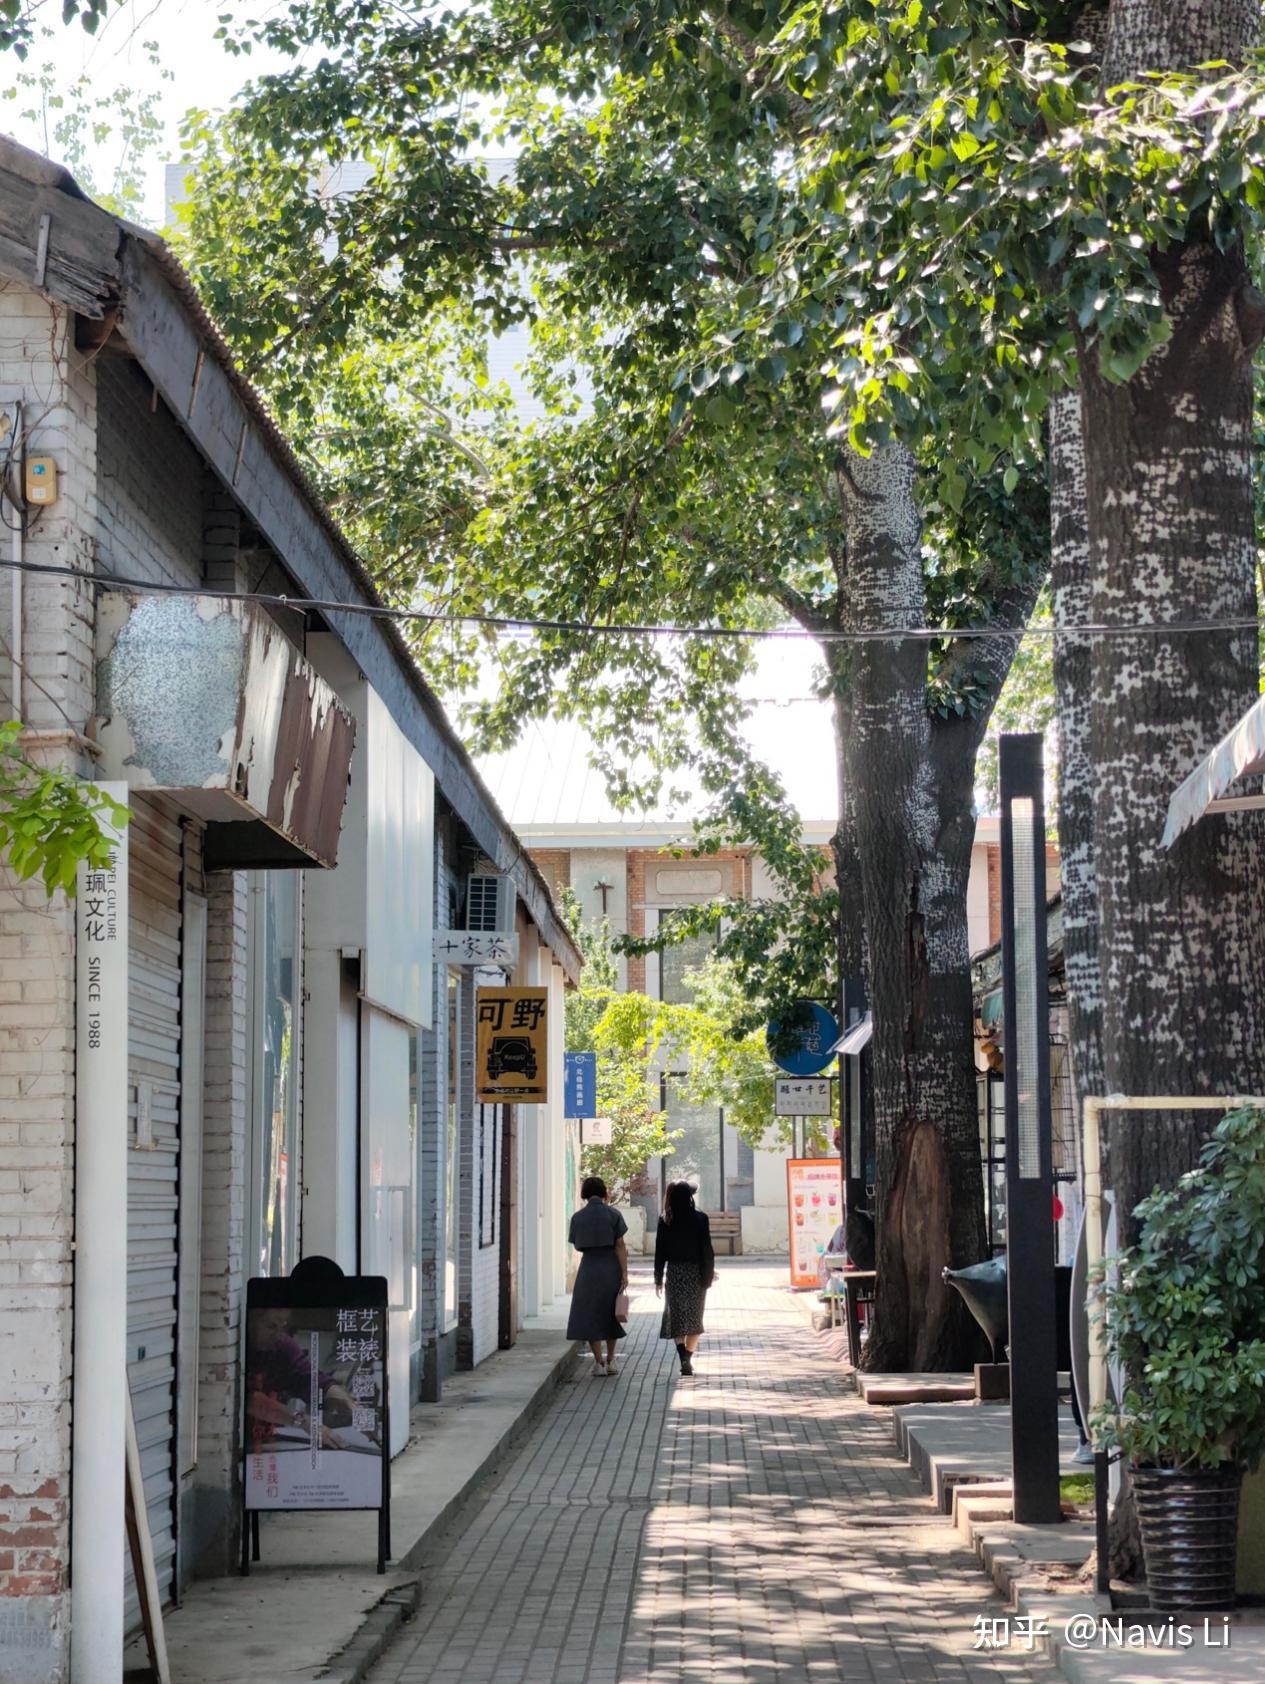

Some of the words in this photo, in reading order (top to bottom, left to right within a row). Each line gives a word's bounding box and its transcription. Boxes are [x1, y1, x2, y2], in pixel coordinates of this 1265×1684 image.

[85, 856, 107, 942] 珮文化
[107, 889, 117, 941] CULTURE
[432, 936, 507, 959] 十家茶
[88, 957, 101, 1002] SINCE
[88, 1012, 101, 1049] 1988
[479, 998, 546, 1031] 可野
